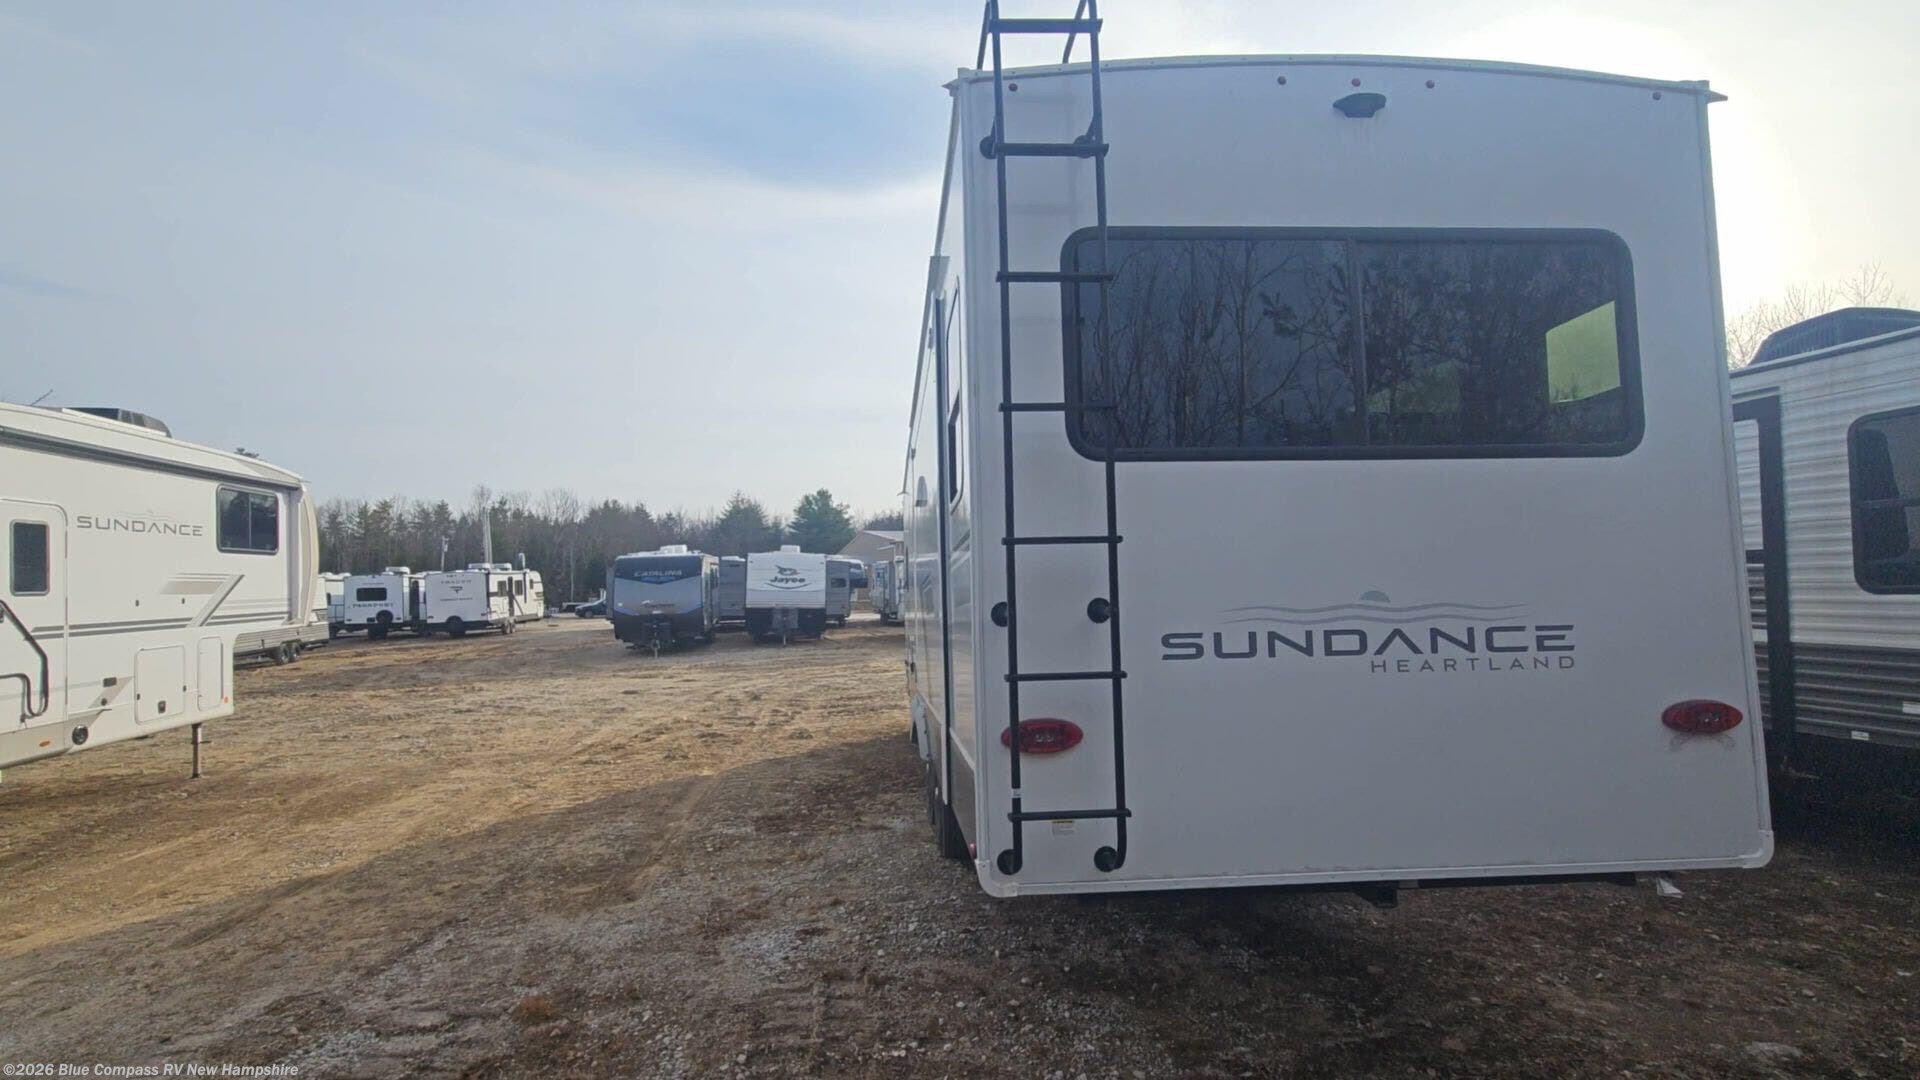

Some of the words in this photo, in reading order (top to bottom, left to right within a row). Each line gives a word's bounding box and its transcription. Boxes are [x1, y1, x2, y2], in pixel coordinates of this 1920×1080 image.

[77, 515, 203, 537] SUNDANCE
[633, 569, 683, 577] CATALINA
[770, 576, 806, 584] Jayco
[1161, 624, 1576, 660] SUNDANCE
[1370, 656, 1576, 674] HEARTLAND
